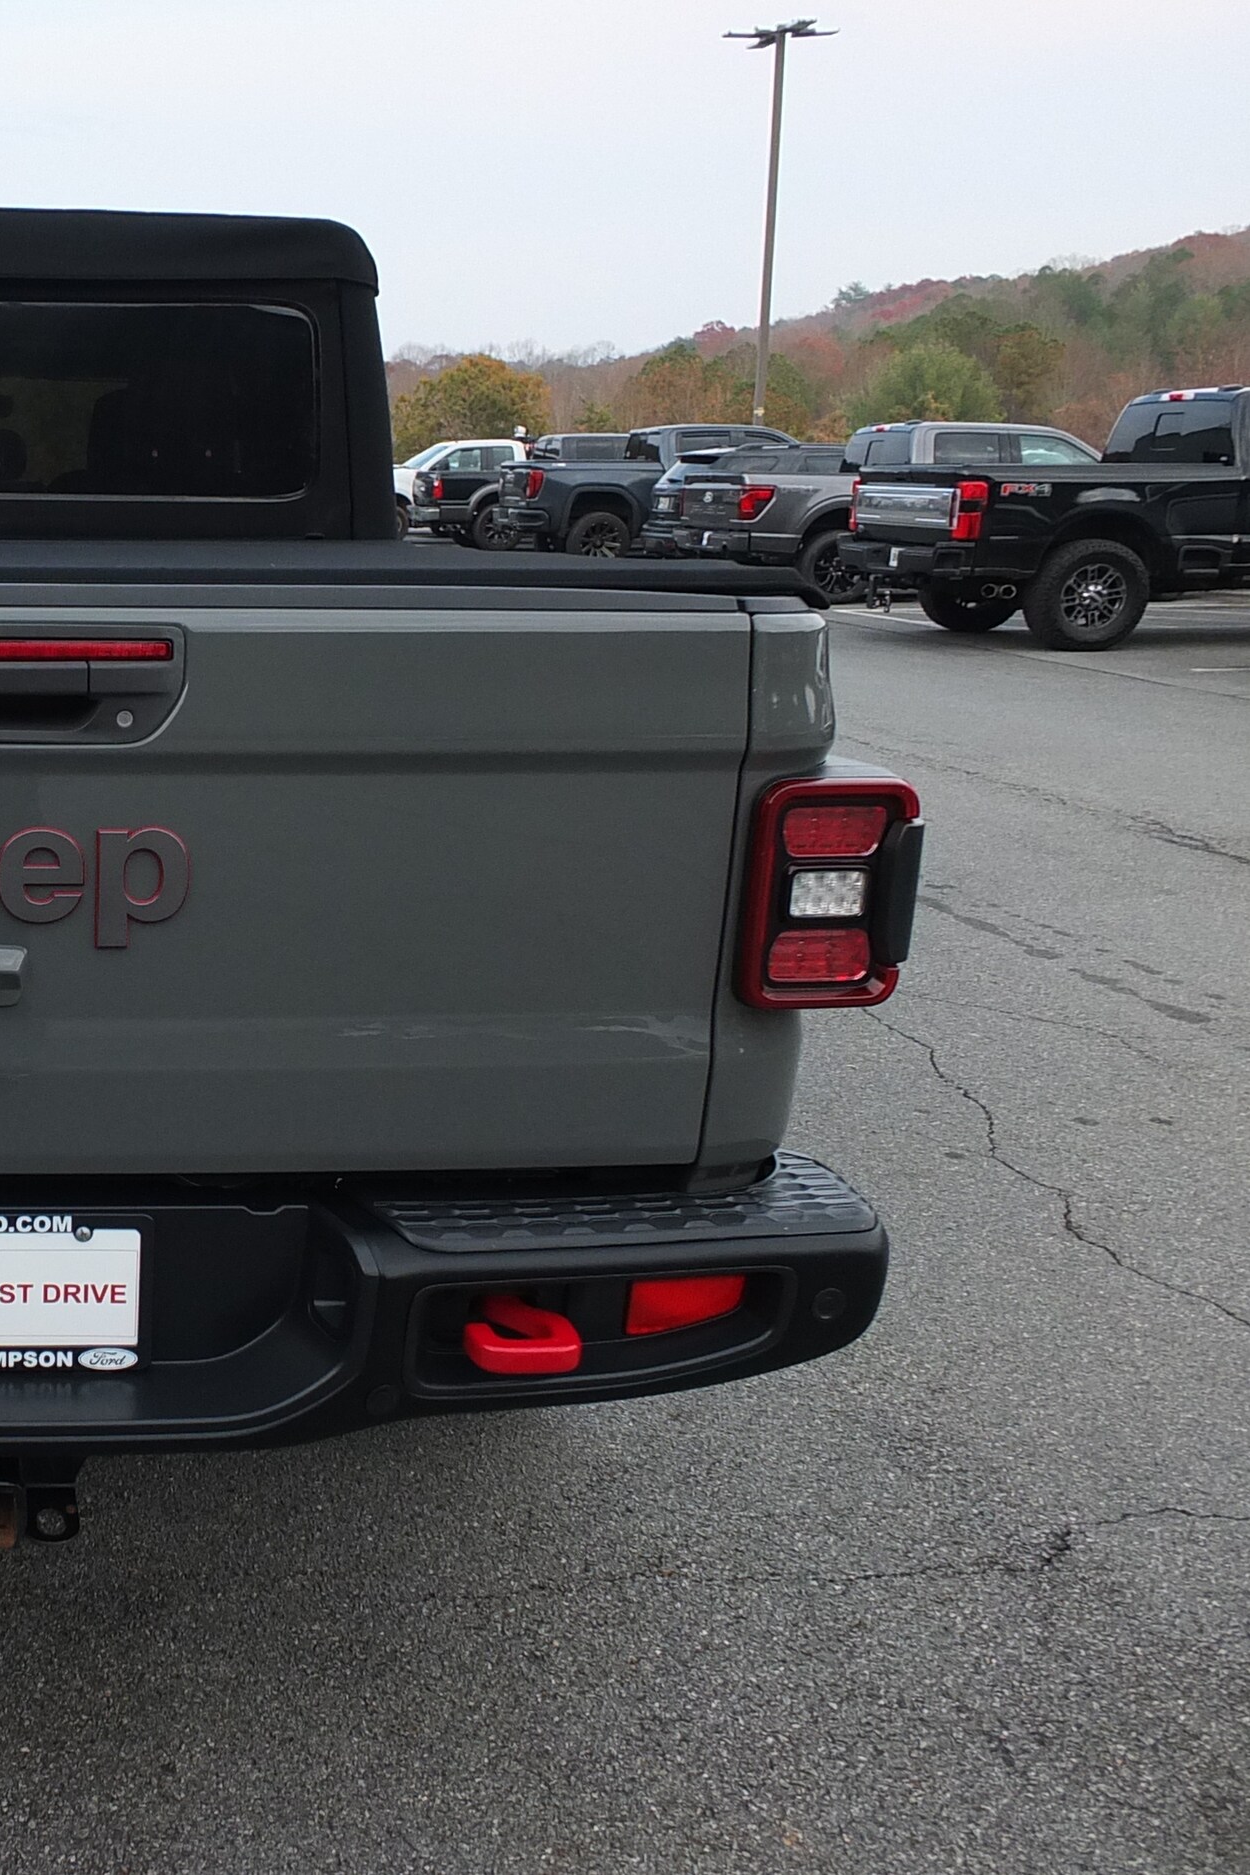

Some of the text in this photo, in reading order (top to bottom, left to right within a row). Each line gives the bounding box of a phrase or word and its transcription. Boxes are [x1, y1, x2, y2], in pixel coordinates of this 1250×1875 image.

[1000, 483, 1052, 497] FX4
[42, 1284, 127, 1304] DRIVE
[89, 1352, 127, 1367] Ford
